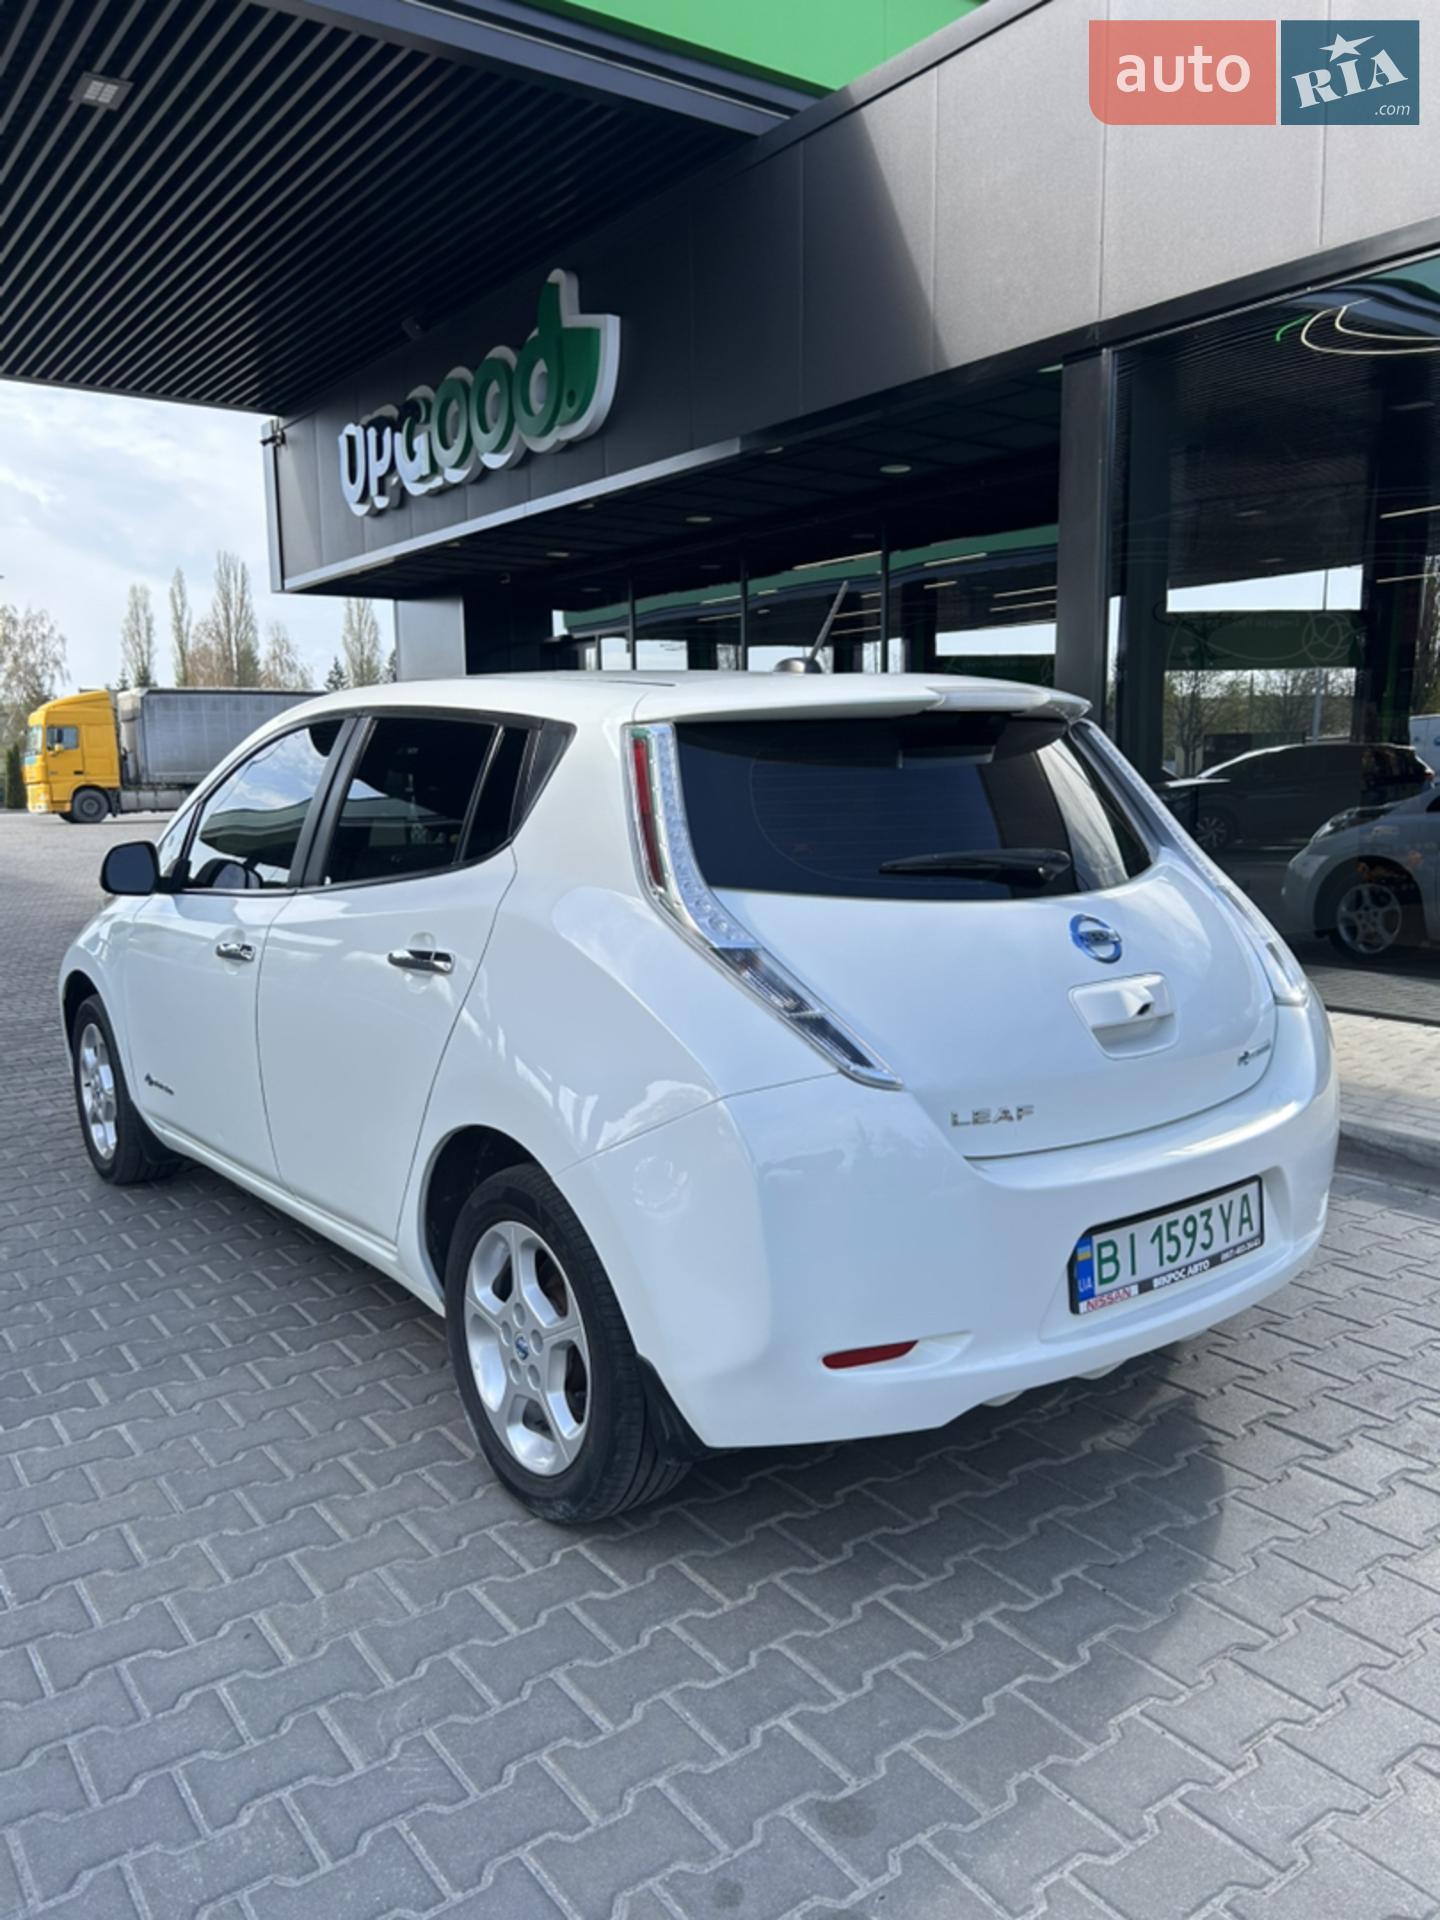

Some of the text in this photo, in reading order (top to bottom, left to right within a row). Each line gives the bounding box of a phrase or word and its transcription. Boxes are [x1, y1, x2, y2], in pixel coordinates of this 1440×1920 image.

[950, 1105, 1035, 1127] LEAF
[1096, 1232, 1137, 1287] BI
[1149, 1207, 1214, 1267] 1593
[1218, 1192, 1255, 1244] YA
[1186, 1259, 1211, 1278] АВТО
[1077, 1278, 1093, 1293] UA
[1087, 1288, 1132, 1312] NISSAN
